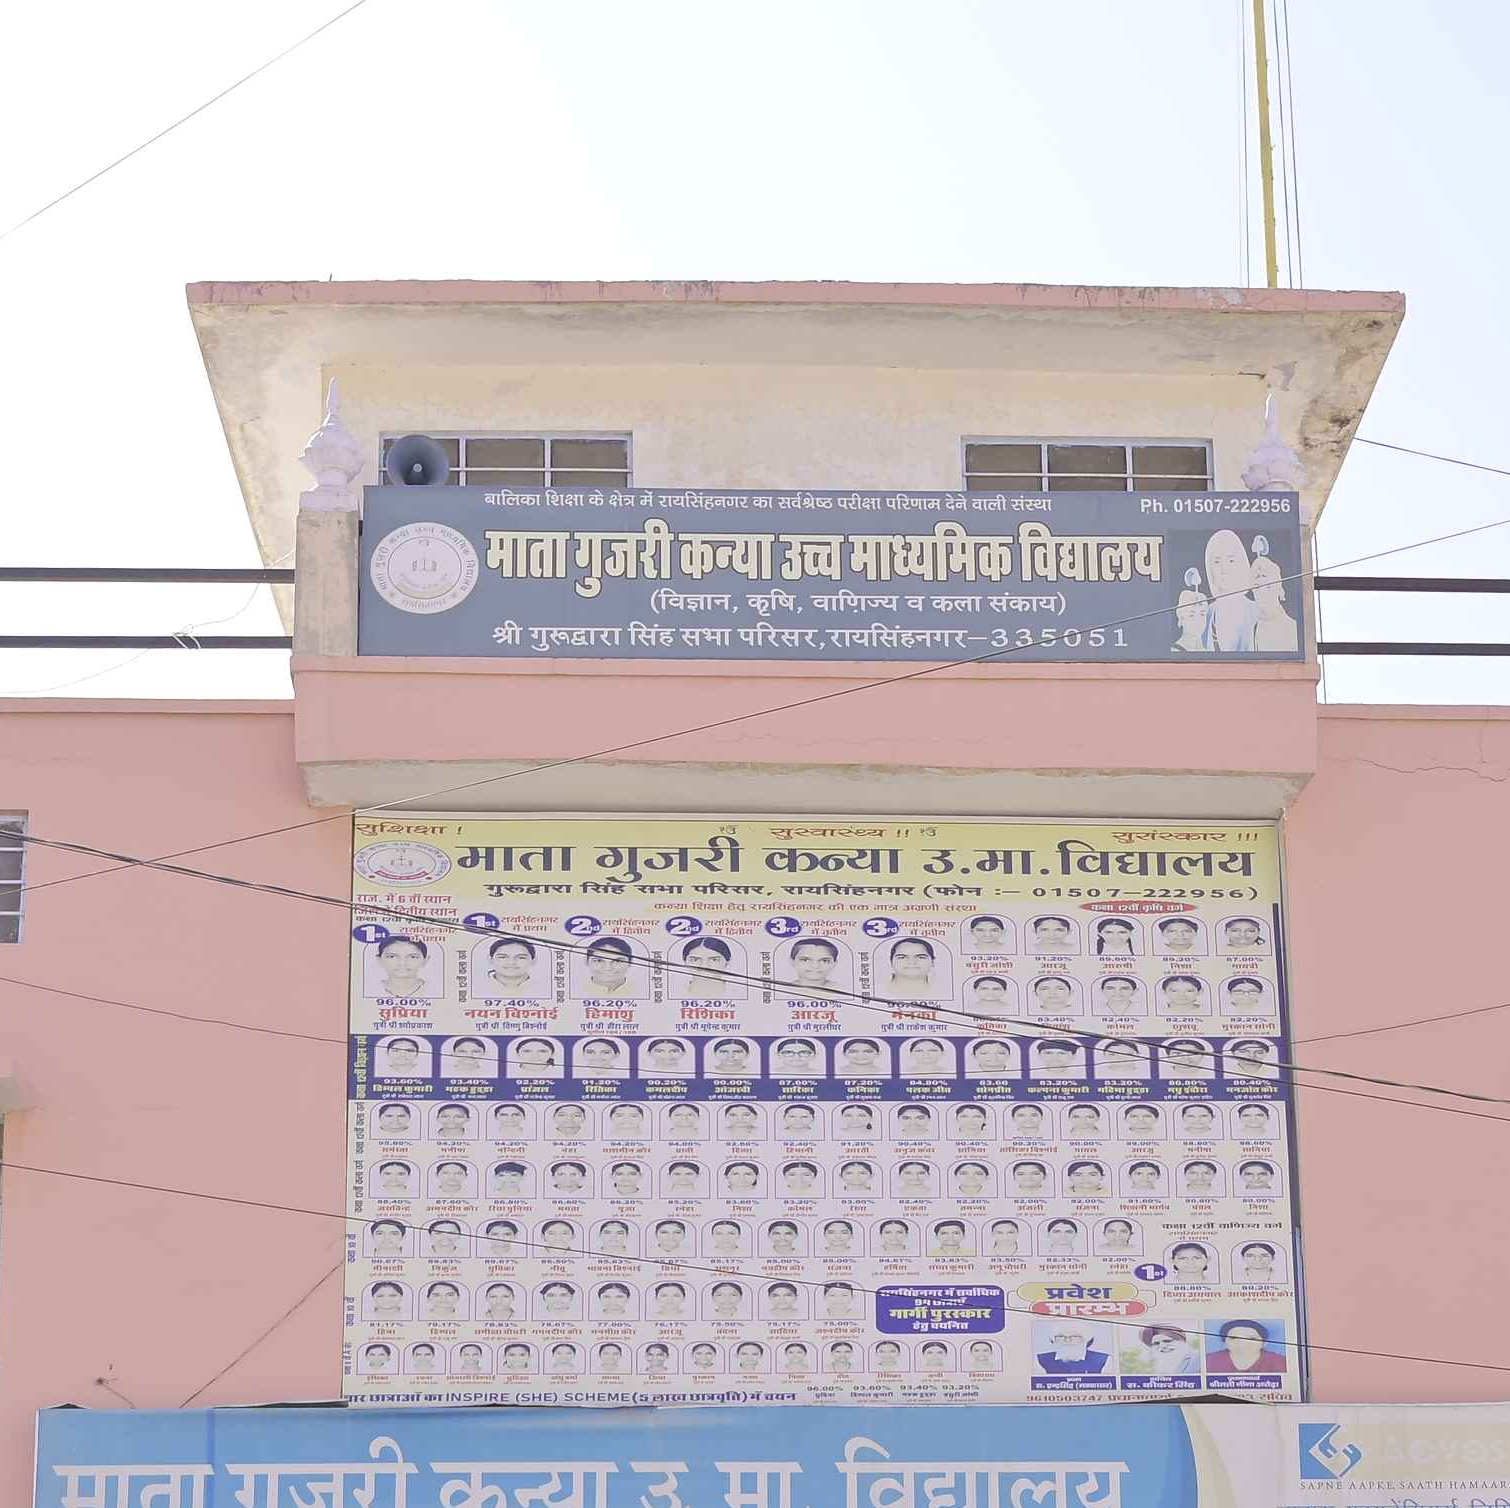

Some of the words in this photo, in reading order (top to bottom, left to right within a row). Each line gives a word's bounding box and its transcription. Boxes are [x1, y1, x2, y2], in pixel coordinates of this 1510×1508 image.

[484, 488, 540, 507] बालिका
[545, 489, 584, 507] शिक्षा
[589, 489, 604, 507] के
[608, 490, 635, 507] क्षेत्र
[640, 490, 653, 508] में
[659, 490, 748, 510] रायसिंहनगर
[753, 496, 773, 509] का
[778, 492, 833, 511] सर्वश्रेष्ठ
[838, 494, 880, 511] परीक्षा
[886, 493, 941, 511] परिणाम
[945, 494, 967, 511] देने
[972, 495, 1007, 512] वाली
[1011, 495, 1052, 512] संस्था
[1140, 499, 1168, 514] Ph.
[1173, 499, 1291, 513] 01507-222956
[484, 530, 572, 579] माता
[572, 517, 675, 599] गुजरी
[678, 532, 776, 581] कन्या
[778, 534, 845, 582] उच्च
[847, 521, 1014, 583] माध्यमिक
[1018, 521, 1164, 583] विद्यालय
[649, 588, 739, 615] (विज्ञान,
[745, 589, 803, 617] कृषि,
[811, 589, 900, 614] वाणिज्य
[904, 595, 924, 612] व
[929, 595, 983, 613] कला
[987, 592, 1067, 617] संकाय)
[492, 619, 523, 646] श्री
[627, 621, 675, 647] सिंह
[680, 627, 732, 647] सभा
[455, 846, 576, 872] माता
[593, 834, 745, 884] गुजरी
[762, 847, 904, 874] कन्या
[580, 881, 626, 895] सिंह
[634, 884, 684, 895] सभा
[780, 882, 916, 897] रायसिंहनगर
[923, 884, 983, 898] (फोन
[749, 902, 823, 912] रायसिंहनगर
[571, 918, 600, 935] 2nd
[670, 918, 700, 935] 2nd
[770, 918, 799, 935] 3rd
[867, 919, 897, 936] 3rd
[375, 999, 432, 1007] 96.00%
[483, 999, 540, 1008] 97.40%
[581, 999, 638, 1008] 96.20%
[681, 1000, 737, 1008] 96.20%
[786, 1000, 842, 1009] 96.00%
[464, 1009, 501, 1020] नयन
[1044, 1283, 1113, 1300] प्रवेश
[446, 1392, 509, 1402] INSPIRE
[515, 1392, 559, 1403] (SHE)
[563, 1392, 630, 1402] SCHEME
[1300, 1480, 1343, 1490] SAPNE
[1399, 1480, 1443, 1490] SAATH
